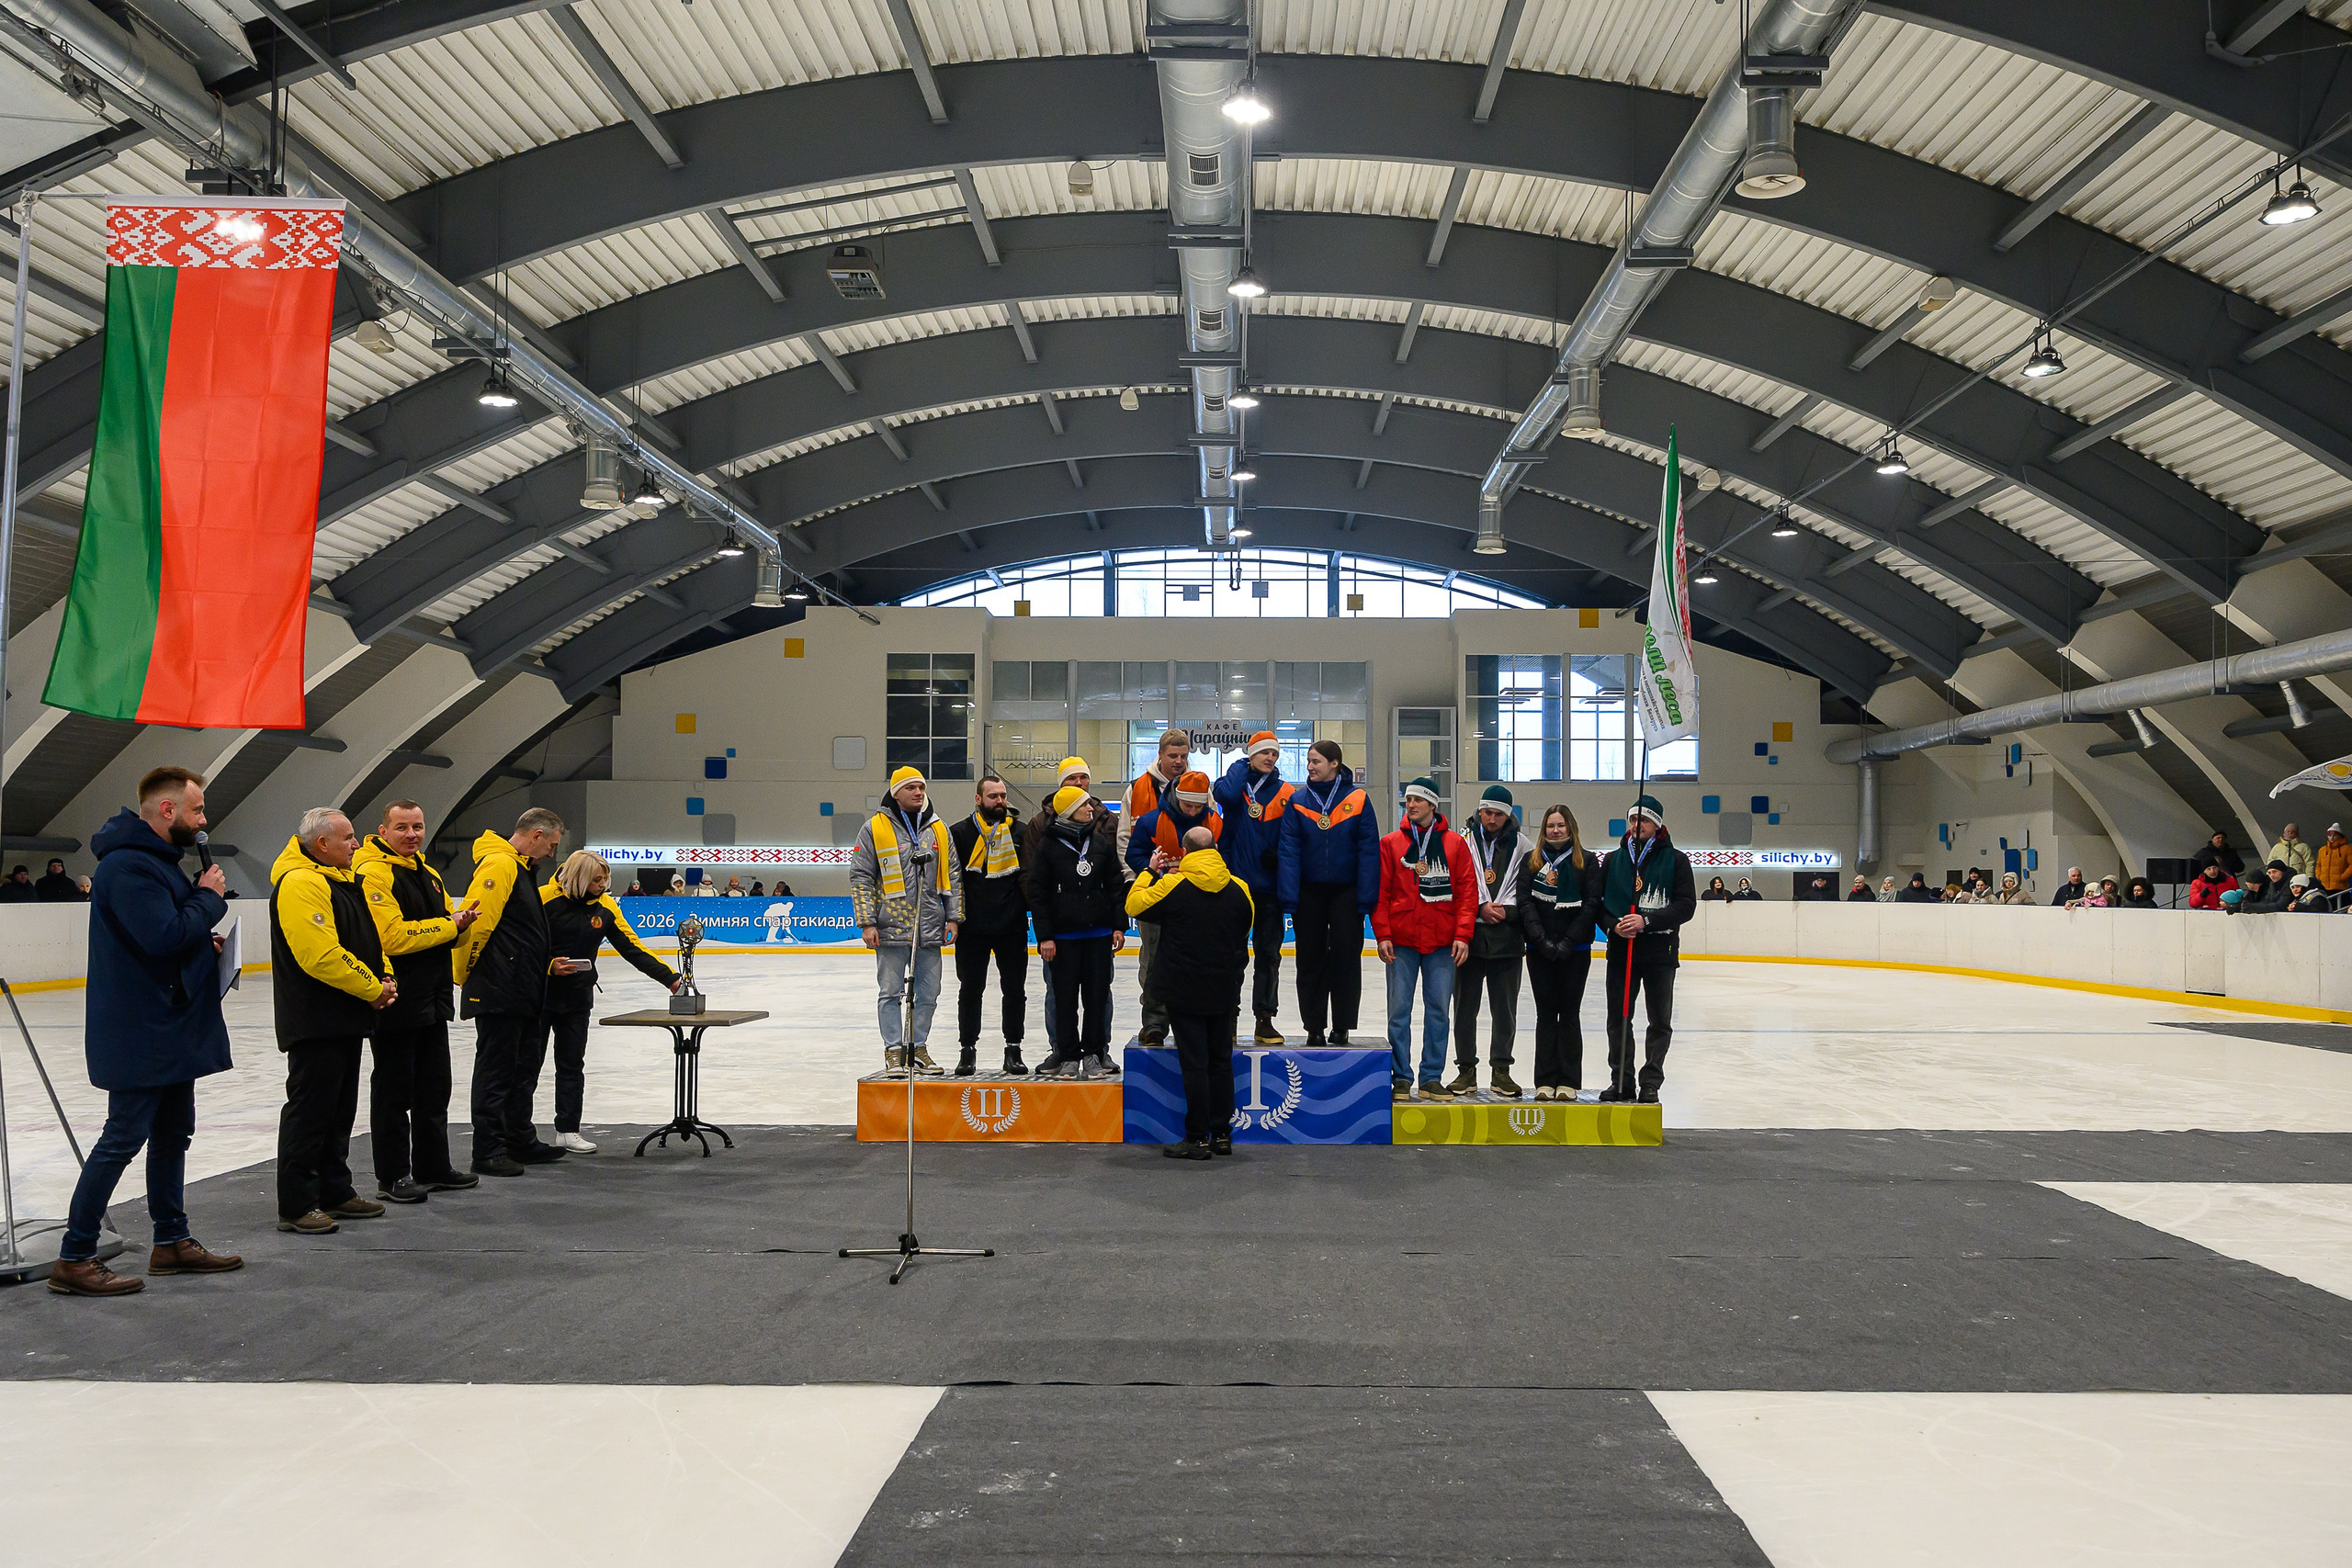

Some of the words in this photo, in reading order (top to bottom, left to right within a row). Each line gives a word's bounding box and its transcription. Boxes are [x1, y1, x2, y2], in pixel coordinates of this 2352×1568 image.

[1656, 674, 1683, 726] леса
[1206, 723, 1238, 731] КАФЕ
[596, 848, 663, 862] ilichy.by
[1760, 852, 1834, 865] silichy.by
[637, 913, 676, 929] 2026
[753, 914, 854, 931] спартакиада
[407, 925, 442, 937] BELARUS
[1242, 1051, 1270, 1111] I
[976, 1089, 1005, 1118] II
[1514, 1108, 1540, 1125] III
